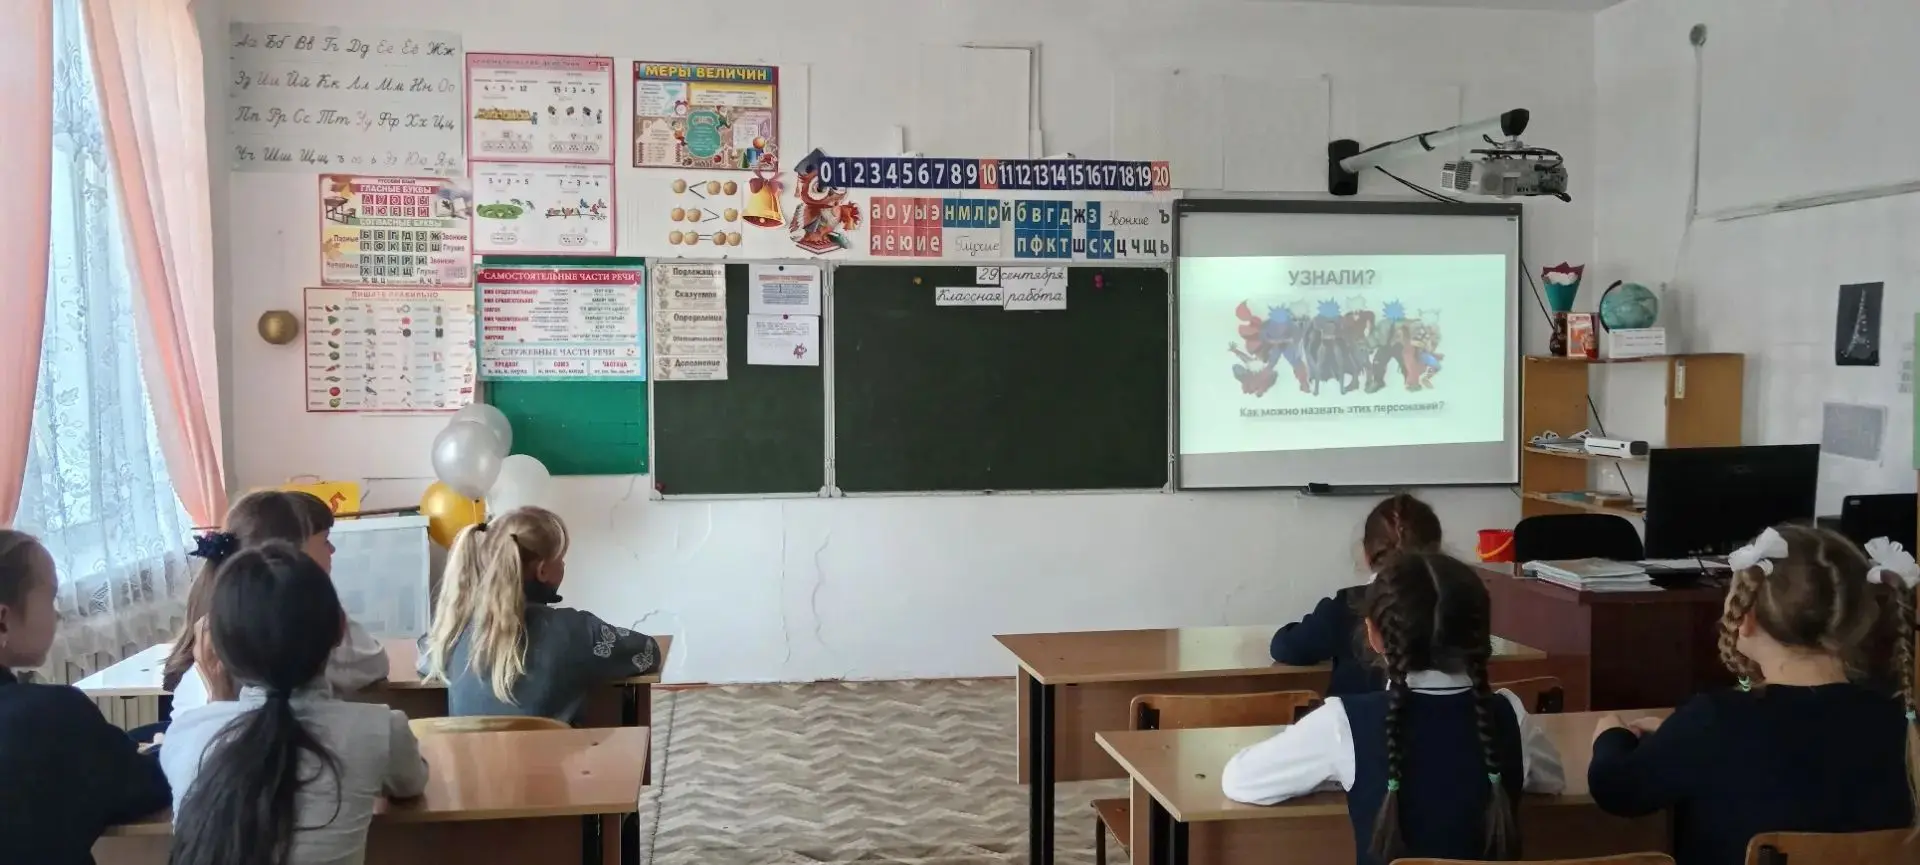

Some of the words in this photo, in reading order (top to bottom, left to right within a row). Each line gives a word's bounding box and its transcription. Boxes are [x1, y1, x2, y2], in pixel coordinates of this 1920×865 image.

[645, 65, 691, 77] МЕРЫ
[696, 67, 767, 80] ВЕЛИЧИН
[820, 161, 832, 183] 0
[835, 162, 846, 183] 1
[854, 162, 865, 183] 2
[870, 162, 880, 184] 3
[886, 162, 897, 184] 4
[903, 162, 912, 184] 5
[918, 163, 929, 185] 6
[934, 163, 945, 184] 7
[951, 163, 962, 185] 8
[966, 163, 977, 185] 9
[982, 164, 996, 185] 10
[999, 164, 1013, 185] 11
[1016, 164, 1031, 185] 12
[1034, 164, 1048, 185] 13
[1050, 164, 1066, 185] 14
[1068, 164, 1084, 185] 15
[1086, 164, 1100, 186] 16
[1102, 165, 1116, 186] 17
[1119, 165, 1134, 186] 18
[1136, 165, 1151, 186] 19
[1153, 166, 1168, 186] 20
[361, 184, 401, 193] ГЛАСНЫЕ
[404, 186, 432, 194] БУКВЫ
[872, 204, 880, 219] а
[886, 204, 896, 219] о
[902, 204, 912, 224] у
[915, 204, 926, 219] ы
[931, 205, 940, 220] э
[945, 206, 954, 220] н
[959, 206, 970, 220] м
[973, 206, 983, 220] л
[988, 206, 997, 225] р
[1002, 202, 1011, 221] й
[1017, 202, 1026, 221] б
[1032, 207, 1041, 221] в
[1047, 207, 1054, 221] г
[1060, 207, 1071, 225] д
[1074, 208, 1086, 224] ж
[1089, 209, 1097, 223] з
[1108, 210, 1151, 226] Звонкие
[1159, 209, 1170, 224] ъ
[872, 236, 880, 250] я
[886, 230, 895, 250] ё
[900, 236, 912, 250] ю
[917, 236, 926, 250] и
[930, 236, 939, 250] е
[956, 236, 1000, 256] Глухие
[1018, 238, 1026, 252] п
[1031, 234, 1042, 256] ф
[1047, 238, 1056, 252] к
[1060, 238, 1068, 252] т
[1073, 239, 1085, 252] ш
[1089, 239, 1098, 253] с
[1103, 239, 1112, 252] х
[1117, 239, 1126, 256] ц
[1132, 239, 1139, 252] ч
[1144, 239, 1156, 256] щ
[1160, 240, 1169, 252] ь
[484, 272, 578, 281] САМОСТОЯТЕЛЬНЫЕ
[580, 272, 610, 281] ЧАСТИ
[612, 273, 634, 281] РЕЧИ
[979, 268, 999, 280] 29
[1288, 268, 1376, 286] УЗНАЛИ?
[501, 348, 557, 356] СЛУЖЕБНЫЕ
[560, 348, 592, 356] ЧАСТИ
[594, 348, 616, 356] РЕЧИ
[1240, 407, 1260, 418] Как
[1261, 406, 1299, 417] можно
[1301, 405, 1344, 415] назвать
[1347, 404, 1372, 414] этих
[1374, 401, 1444, 414] персонажей?
